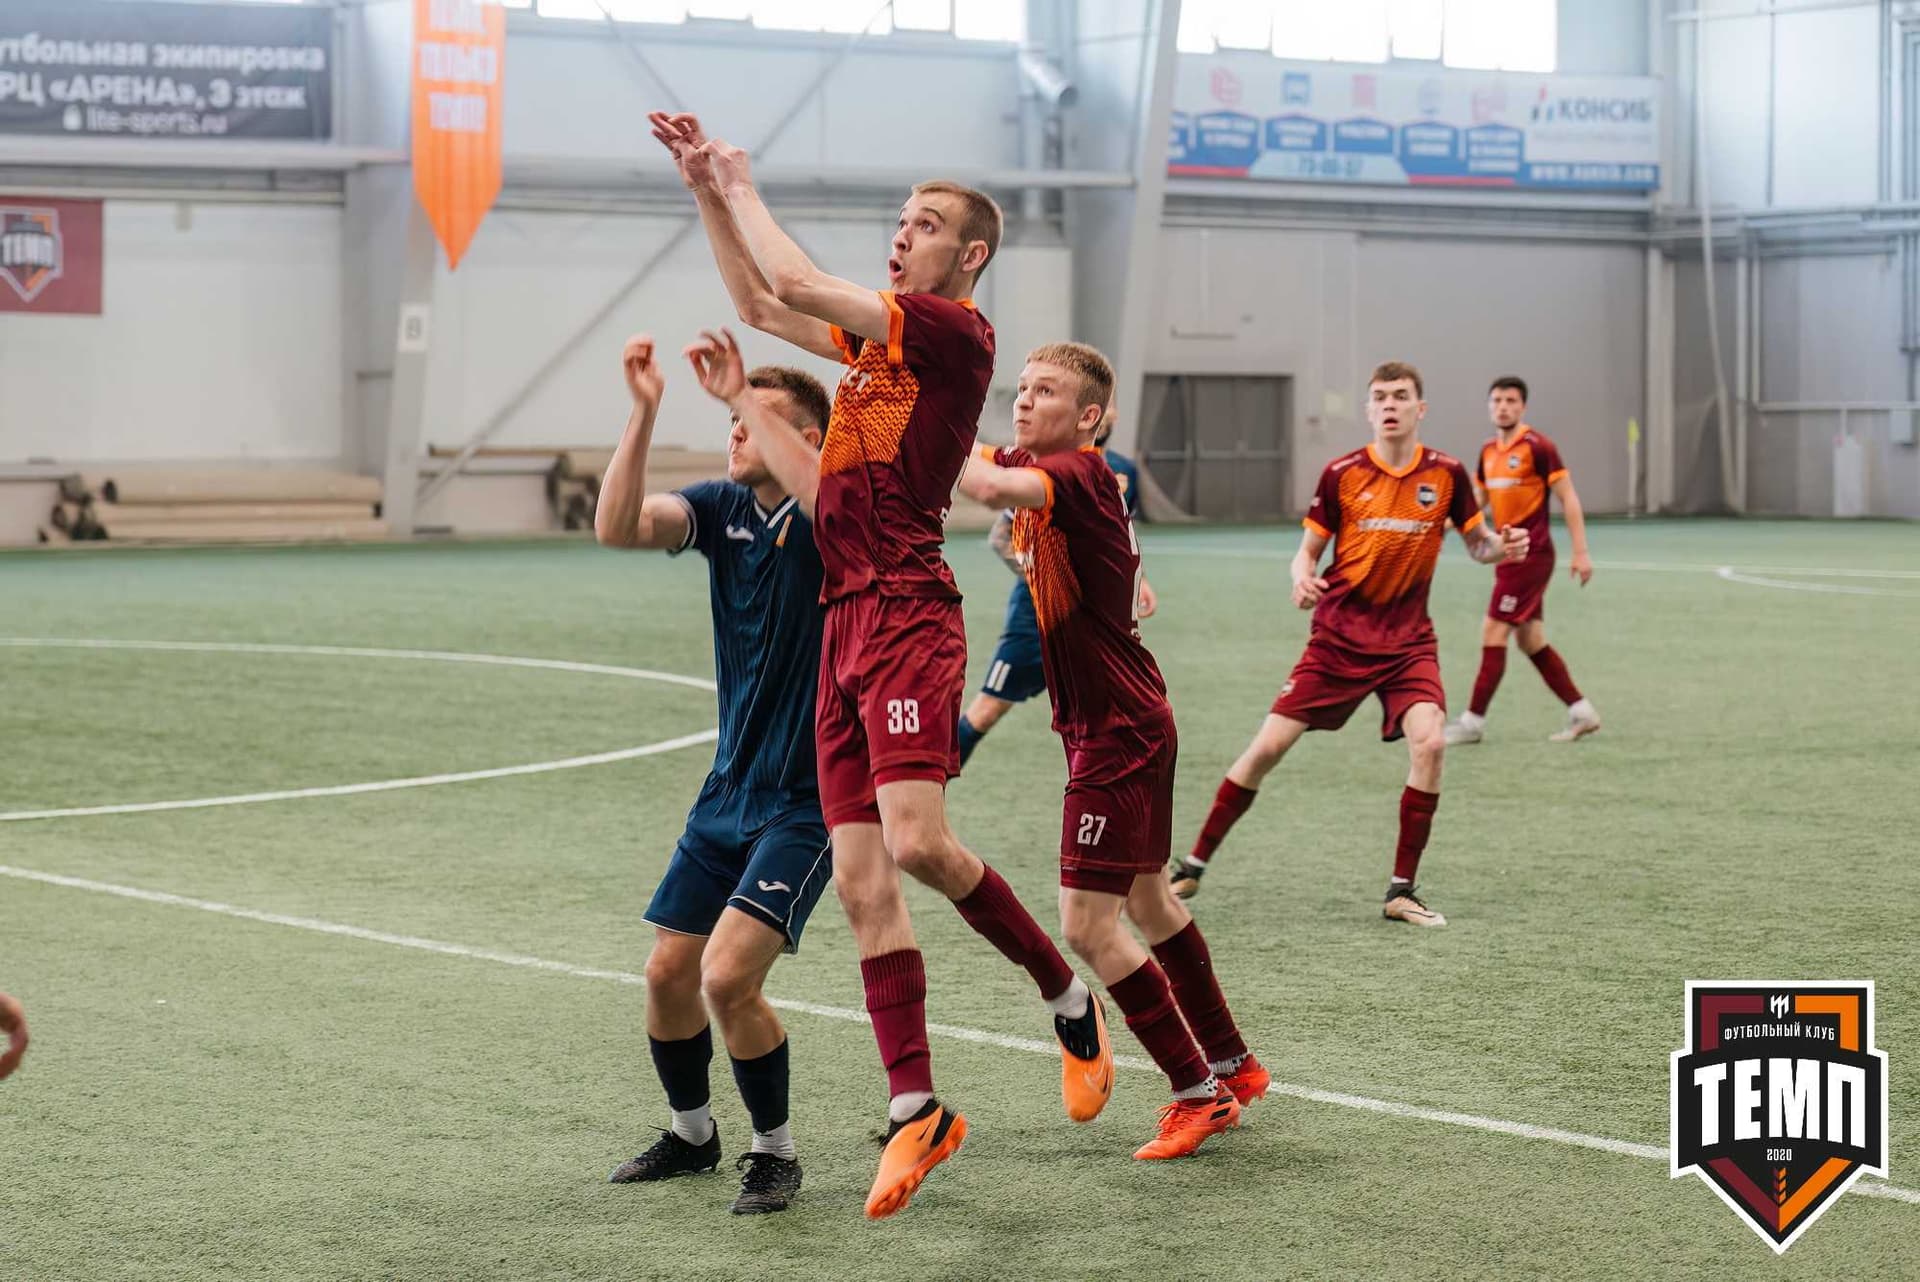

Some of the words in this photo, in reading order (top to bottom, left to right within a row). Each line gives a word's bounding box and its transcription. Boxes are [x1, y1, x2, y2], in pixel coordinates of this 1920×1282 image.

[153, 43, 326, 75] экипировка
[209, 78, 232, 107] 3
[235, 85, 307, 108] этаж
[1558, 97, 1652, 121] КОНСИБ
[985, 659, 1012, 692] 11
[887, 698, 920, 735] 33
[1077, 813, 1107, 846] 27
